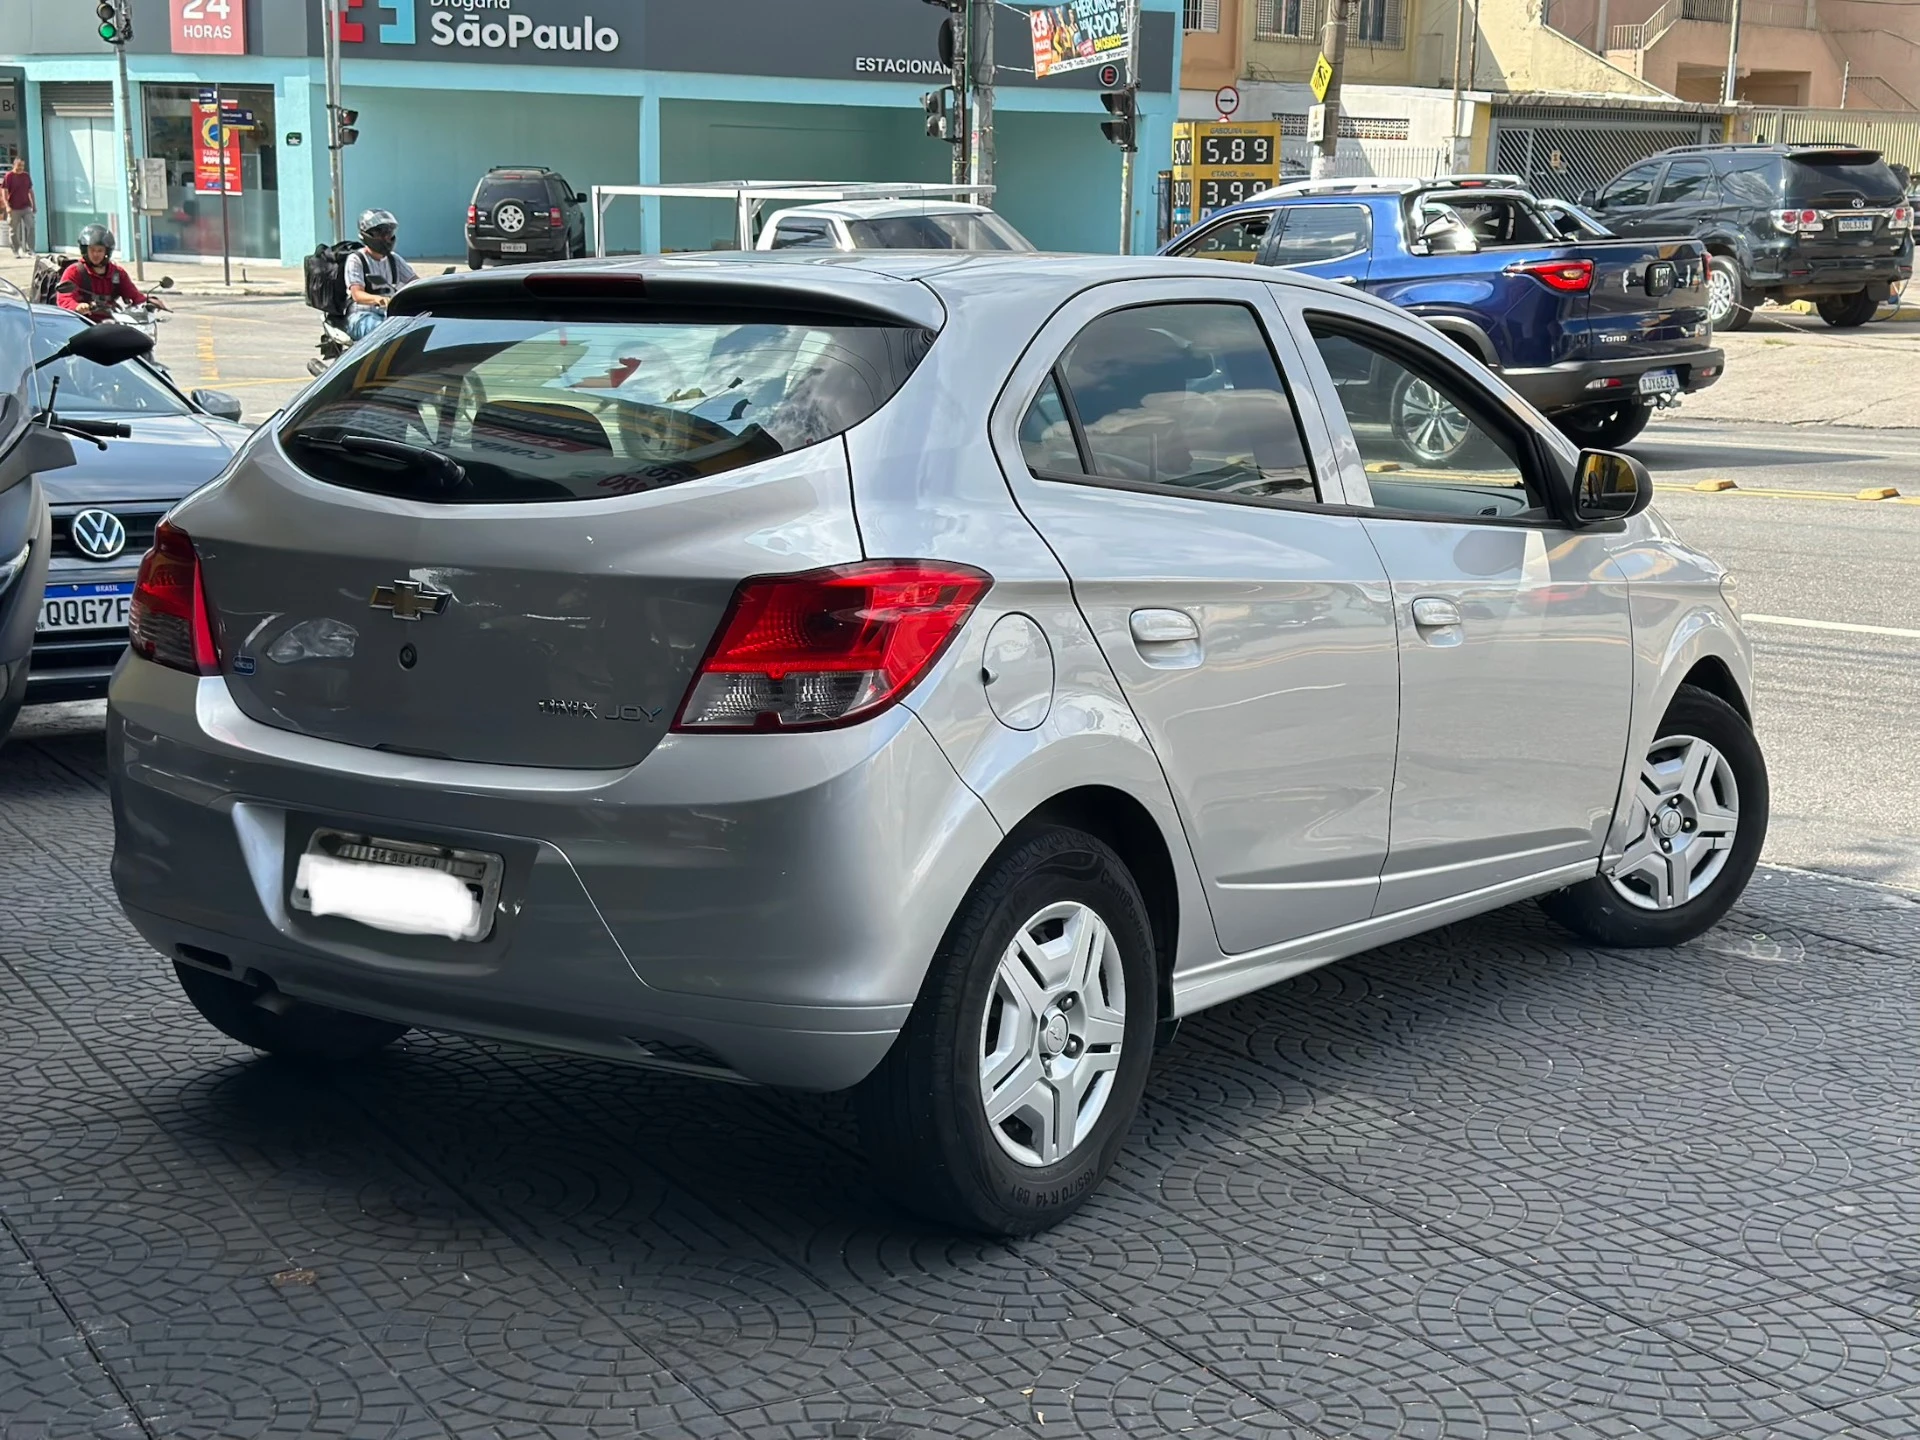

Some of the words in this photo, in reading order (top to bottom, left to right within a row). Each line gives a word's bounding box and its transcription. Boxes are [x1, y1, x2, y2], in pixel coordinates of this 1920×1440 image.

[183, 0, 231, 19] 24
[183, 25, 232, 39] HORAS
[1086, 11, 1119, 39] K-POP
[1104, 68, 1115, 82] E
[1207, 138, 1268, 165] 5,89
[1642, 376, 1676, 391] RJX6E23
[95, 584, 120, 593] BRASIL
[604, 704, 663, 723] JOY
